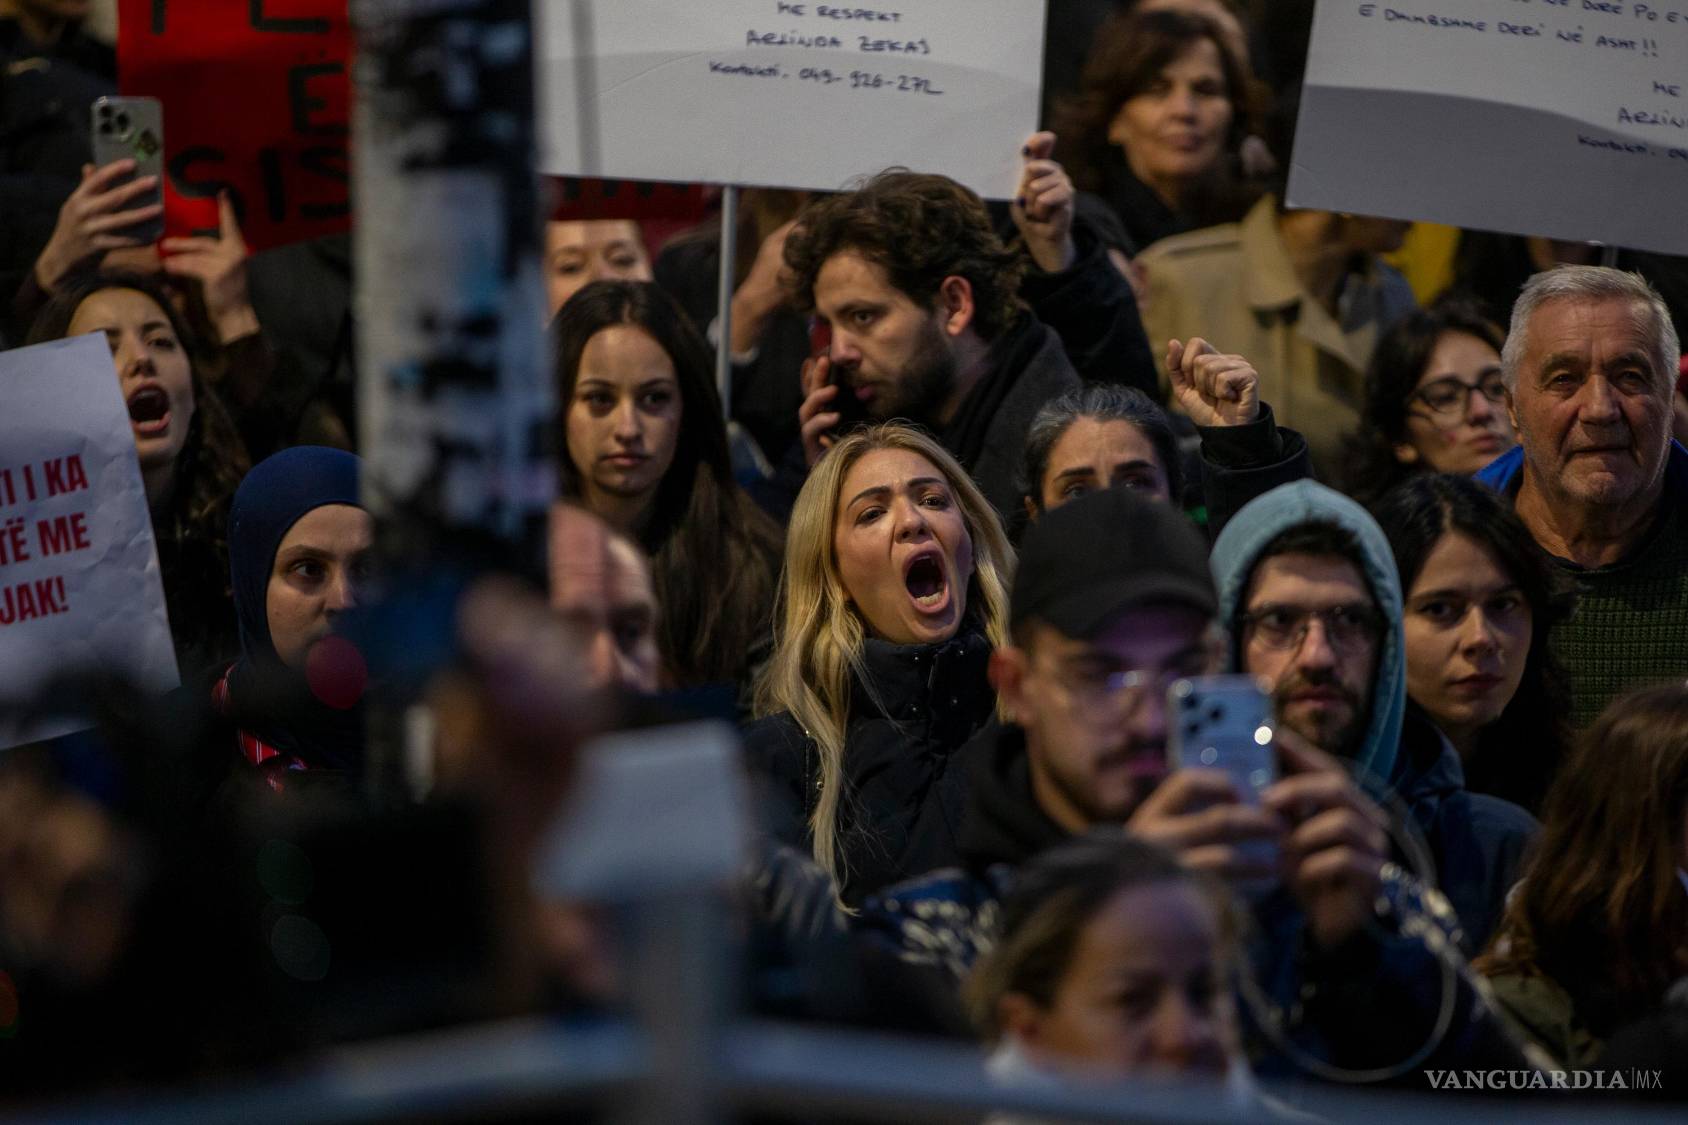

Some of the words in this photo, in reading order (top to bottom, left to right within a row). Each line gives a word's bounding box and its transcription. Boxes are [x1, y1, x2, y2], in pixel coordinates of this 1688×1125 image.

[817, 5, 902, 23] RESPEKT
[1358, 4, 1377, 18] E
[23, 464, 37, 502] I
[43, 453, 89, 497] KA
[37, 512, 91, 557] ME
